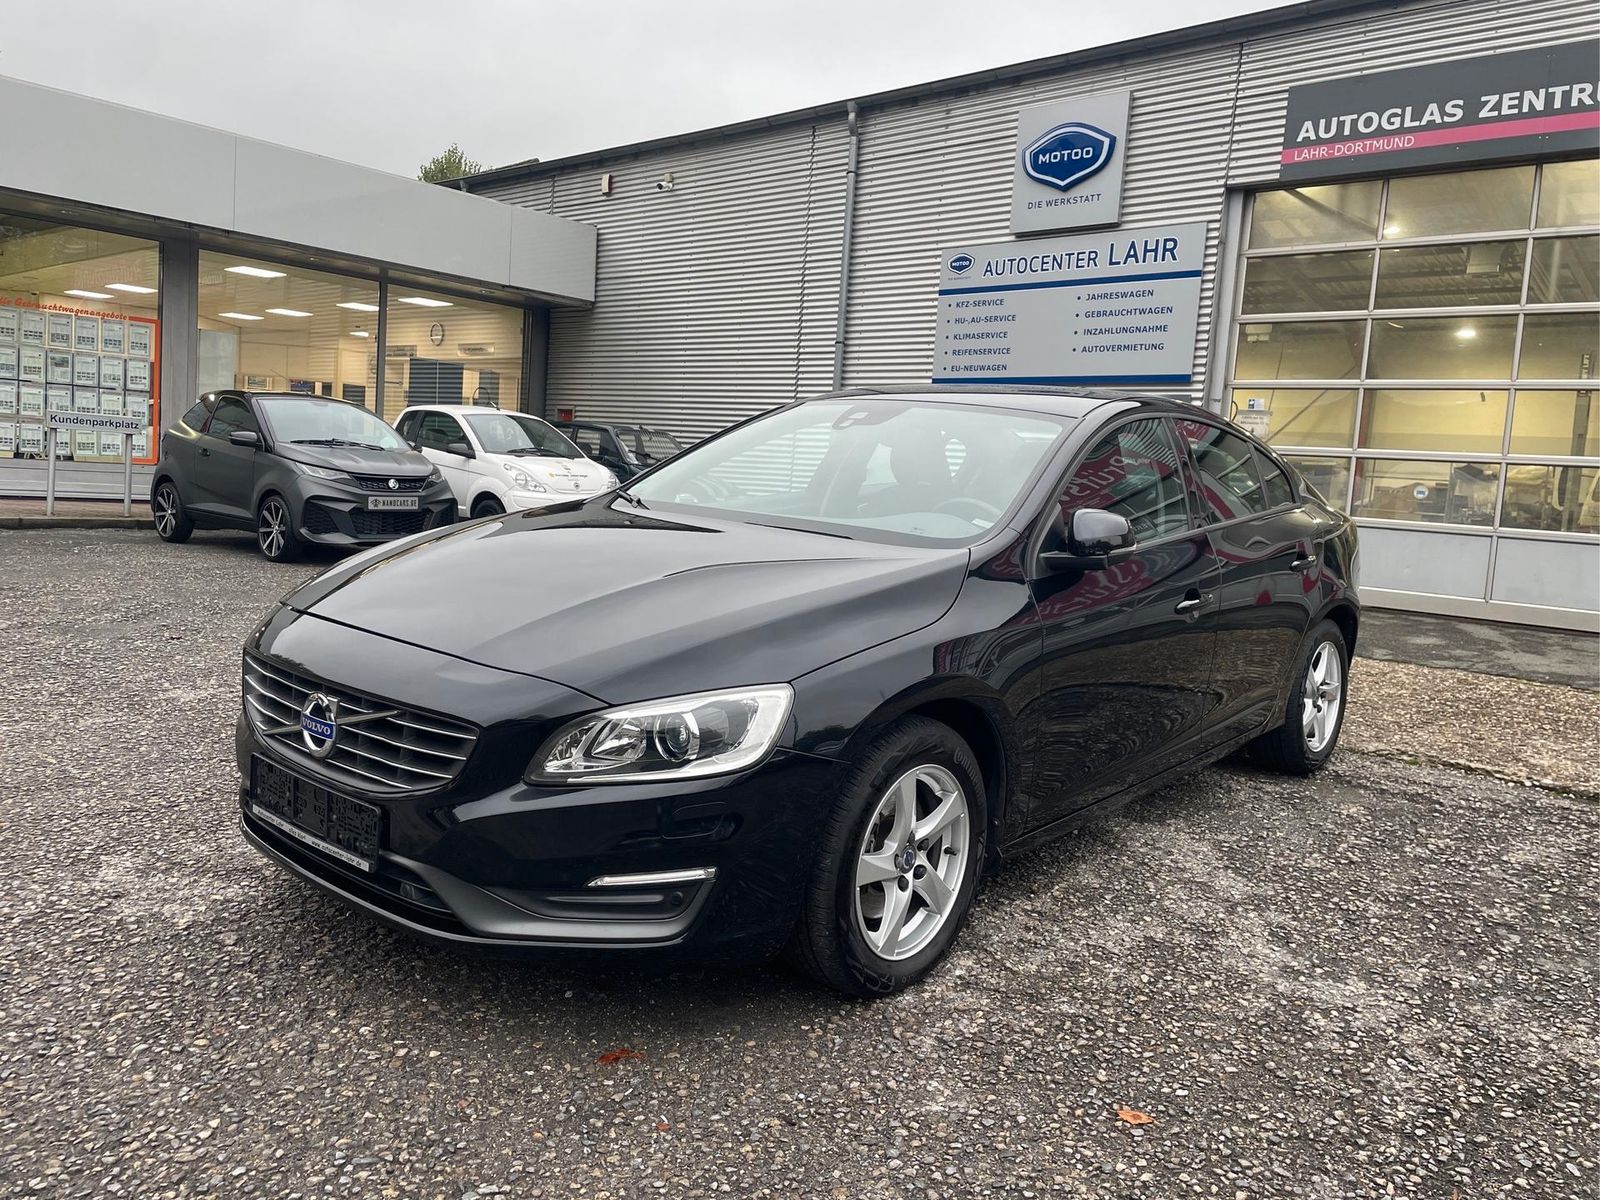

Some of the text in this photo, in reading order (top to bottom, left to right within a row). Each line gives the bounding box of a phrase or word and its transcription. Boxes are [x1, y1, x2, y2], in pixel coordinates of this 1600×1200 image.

[1296, 82, 1600, 142] AUTOGLAS ZENTR
[1293, 136, 1415, 161] LAHR-DORTMUND
[1038, 147, 1093, 164] MOTOO
[1028, 194, 1101, 210] DIE WERKSTATT
[982, 236, 1179, 278] AUTOCENTER LAHR
[1086, 289, 1154, 301] JAHRESWAGEN
[956, 299, 1005, 308] KFZ-SERVICE
[1085, 306, 1173, 318] GEBRAUCHTWAGEN
[953, 331, 1009, 340] KLIMASERVICE
[1083, 325, 1169, 336] INZAHLUNGNAHME
[952, 347, 1012, 356] REIFENSERVICE
[1081, 343, 1165, 353] AUTOVERMIETUNG
[951, 364, 1007, 372] EU-NEUWAGEN
[50, 414, 140, 430] Kundenparkplatz
[302, 717, 331, 735] VOLVO
